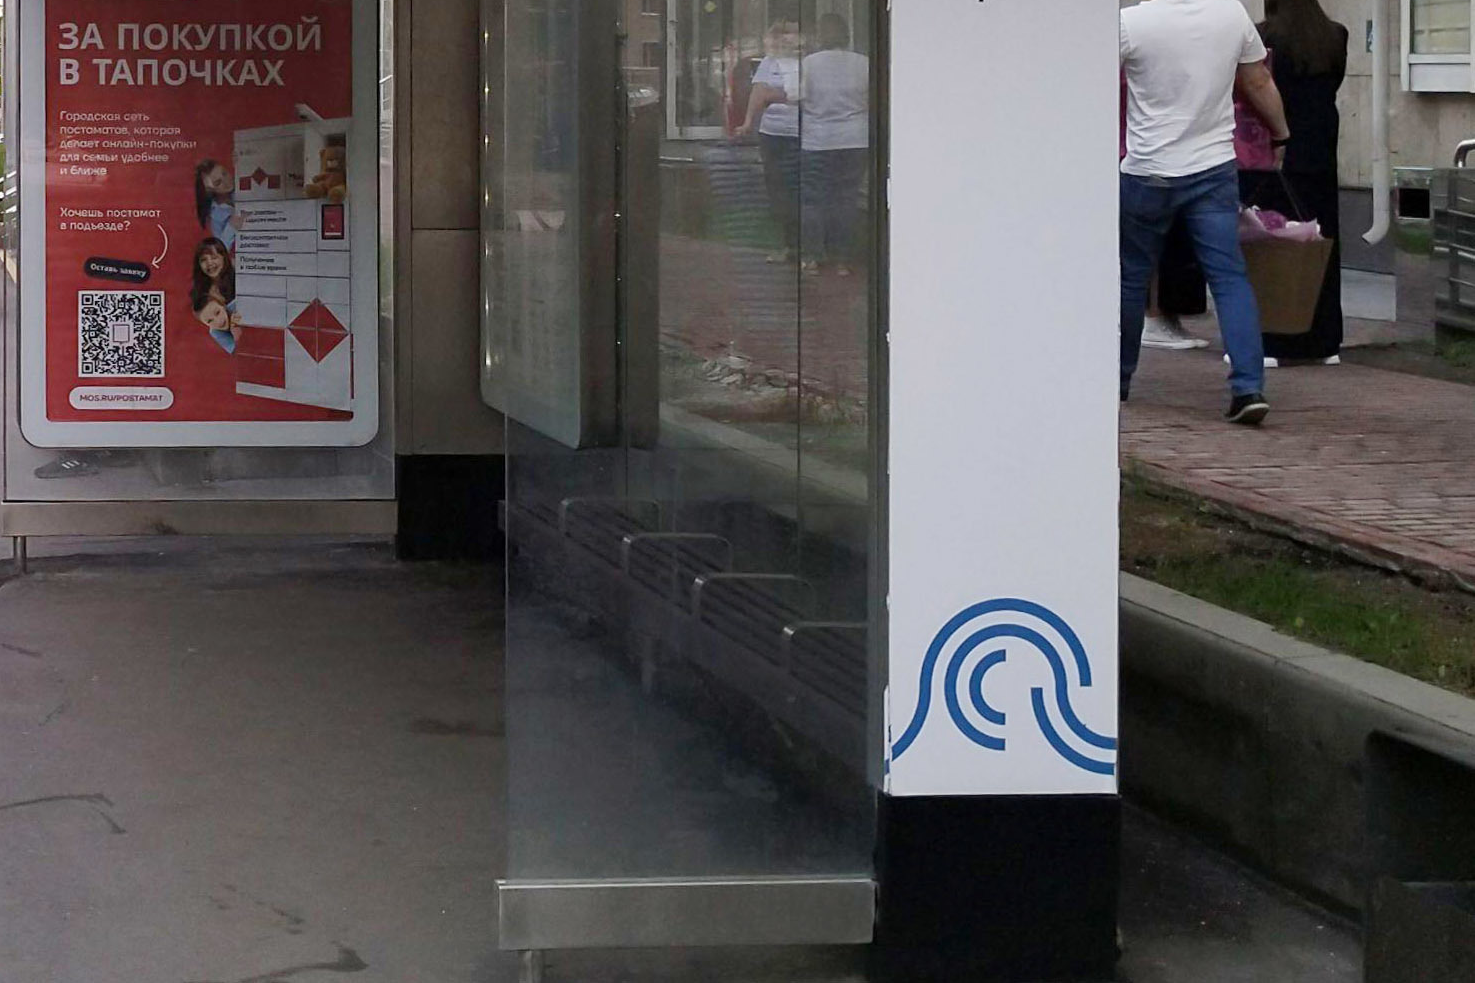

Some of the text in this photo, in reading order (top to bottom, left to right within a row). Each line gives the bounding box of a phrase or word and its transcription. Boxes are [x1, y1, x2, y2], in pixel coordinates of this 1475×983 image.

[58, 16, 322, 51] ЗА ПОКУПКОЙ
[59, 58, 286, 86] В ТАПОЧКАХ
[59, 110, 150, 122] Городская сеть
[133, 127, 181, 136] которая
[59, 137, 197, 150] делает онлайн-покупки
[59, 152, 169, 164] для семьи удобнее
[59, 165, 107, 175] и ближе
[60, 207, 161, 218] Хочешь постамат
[60, 222, 67, 230] в
[79, 394, 164, 402] MOS.RU/POSTAMAT
